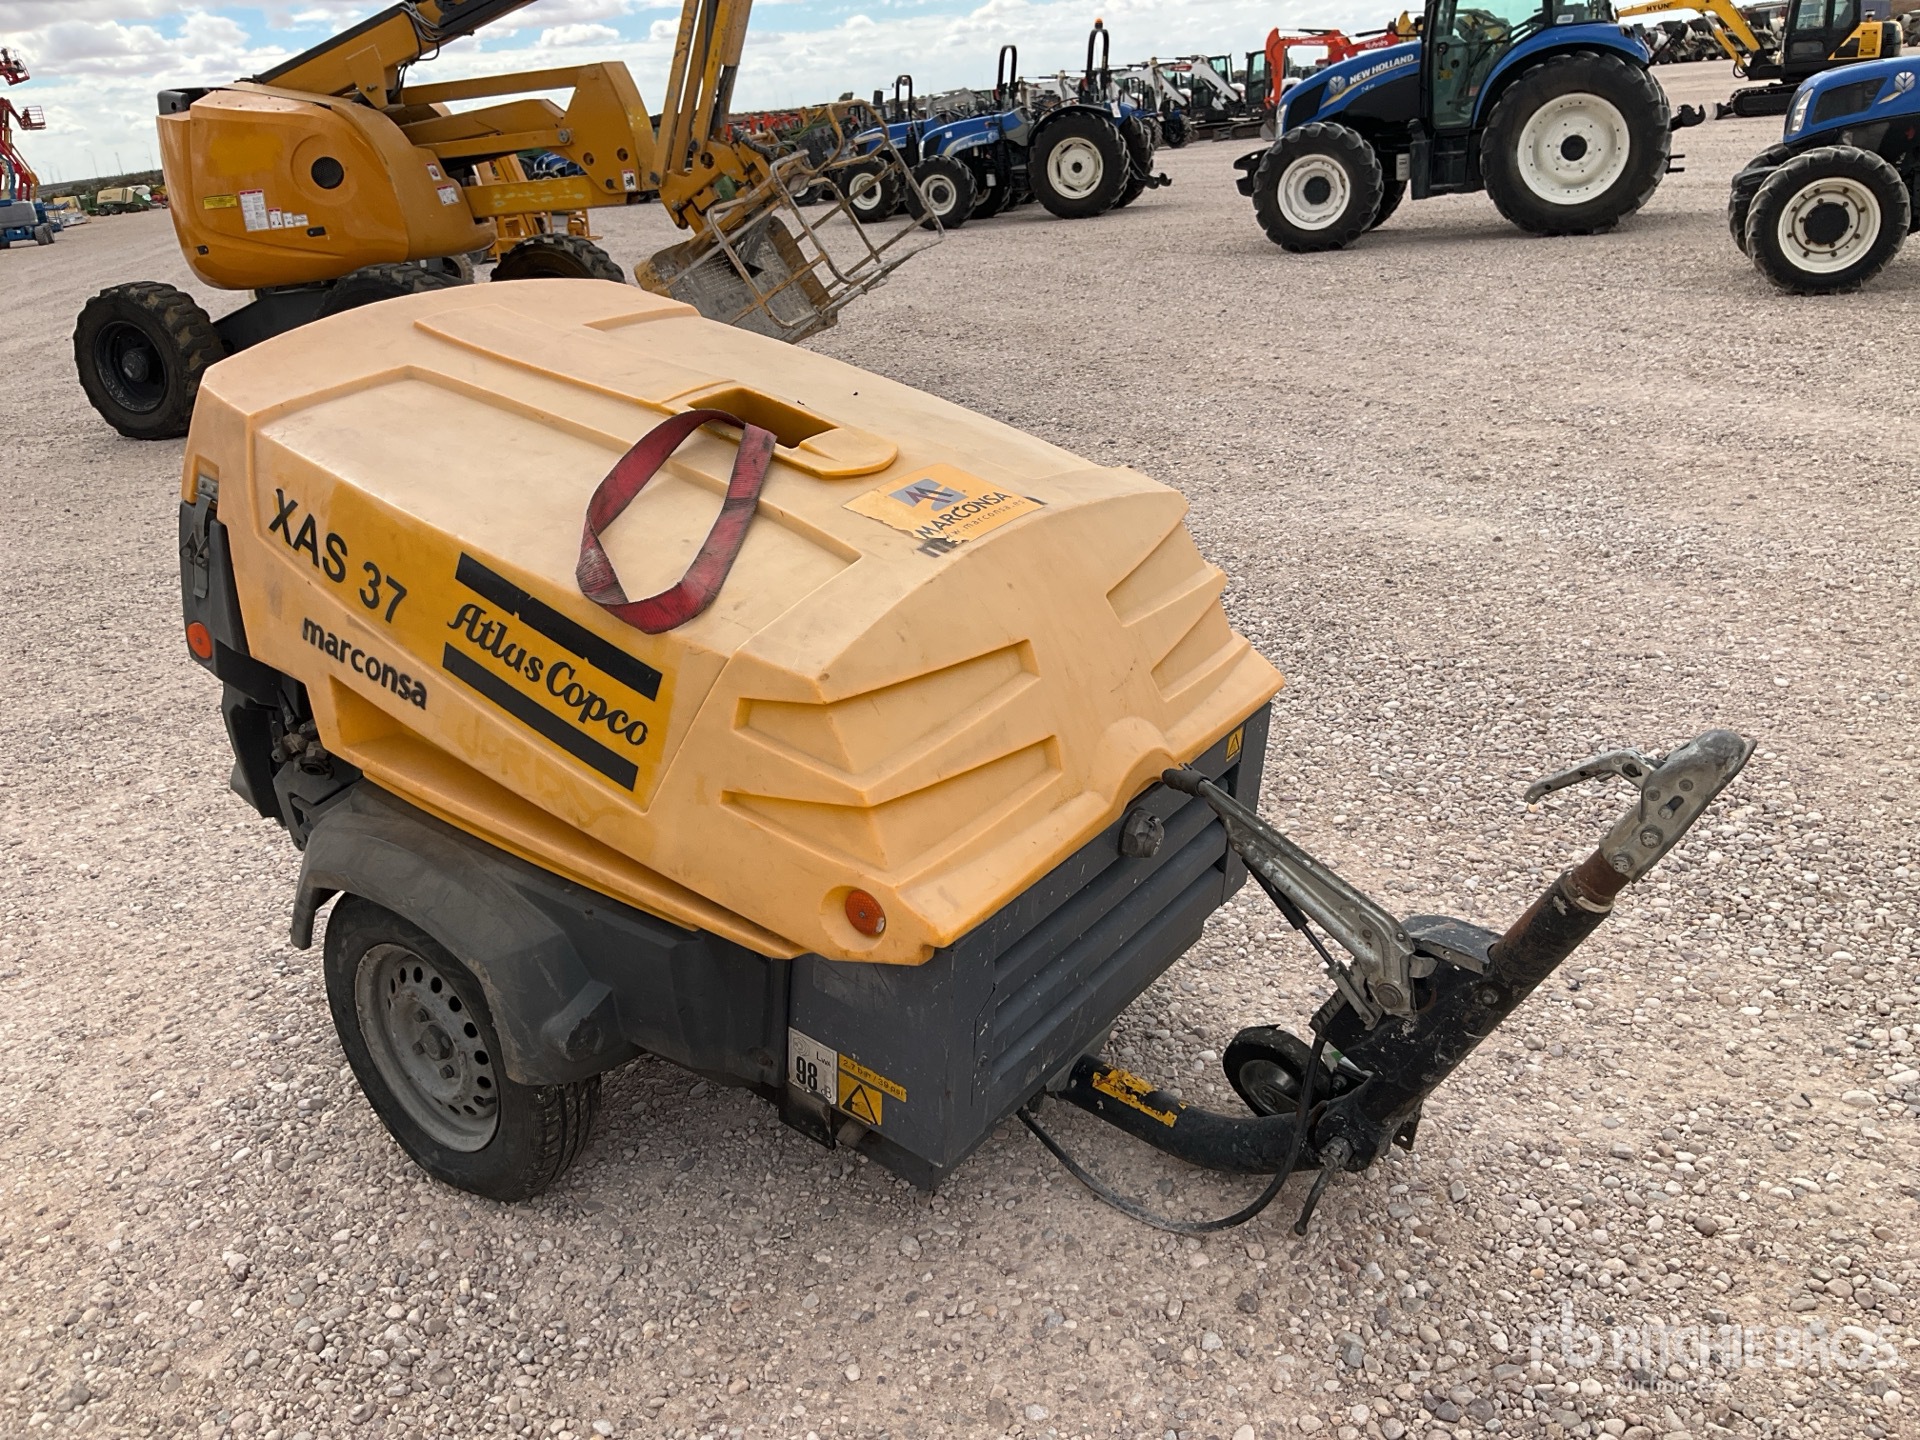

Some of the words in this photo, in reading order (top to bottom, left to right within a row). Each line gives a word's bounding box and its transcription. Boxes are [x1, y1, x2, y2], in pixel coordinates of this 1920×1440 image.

[1349, 68, 1370, 85] NEW
[1371, 54, 1414, 74] HOLLAND
[915, 491, 1012, 540] MARCONSA
[268, 487, 349, 584] XAS
[359, 561, 408, 624] 37
[302, 617, 428, 711] marconsa
[446, 602, 544, 683] Atlas
[546, 660, 649, 747] Copco
[795, 1056, 818, 1091] 98
